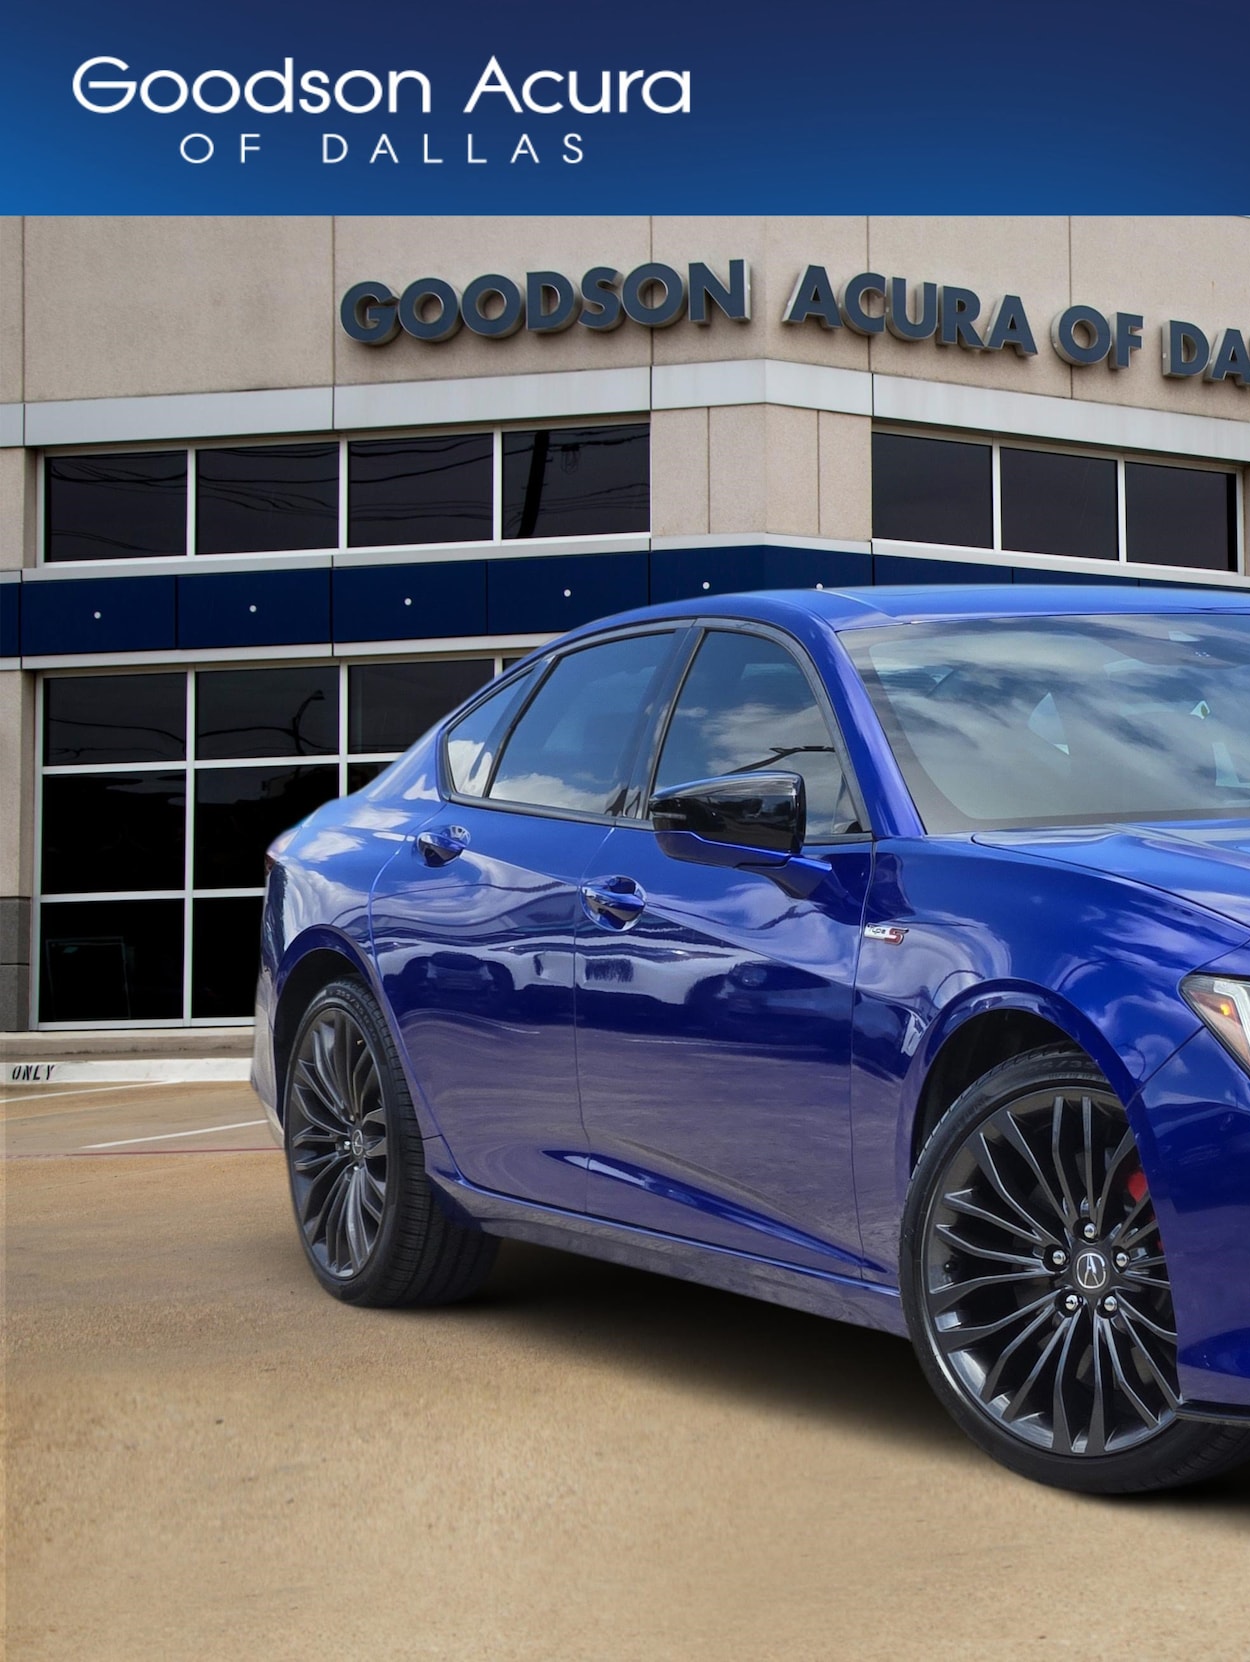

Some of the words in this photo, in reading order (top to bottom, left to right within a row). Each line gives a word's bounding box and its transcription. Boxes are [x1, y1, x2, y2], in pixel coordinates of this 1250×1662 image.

[339, 257, 752, 348] GOODSON
[782, 264, 1039, 358] ACURA
[1050, 304, 1145, 370] OF
[12, 1064, 56, 1081] ONLY
